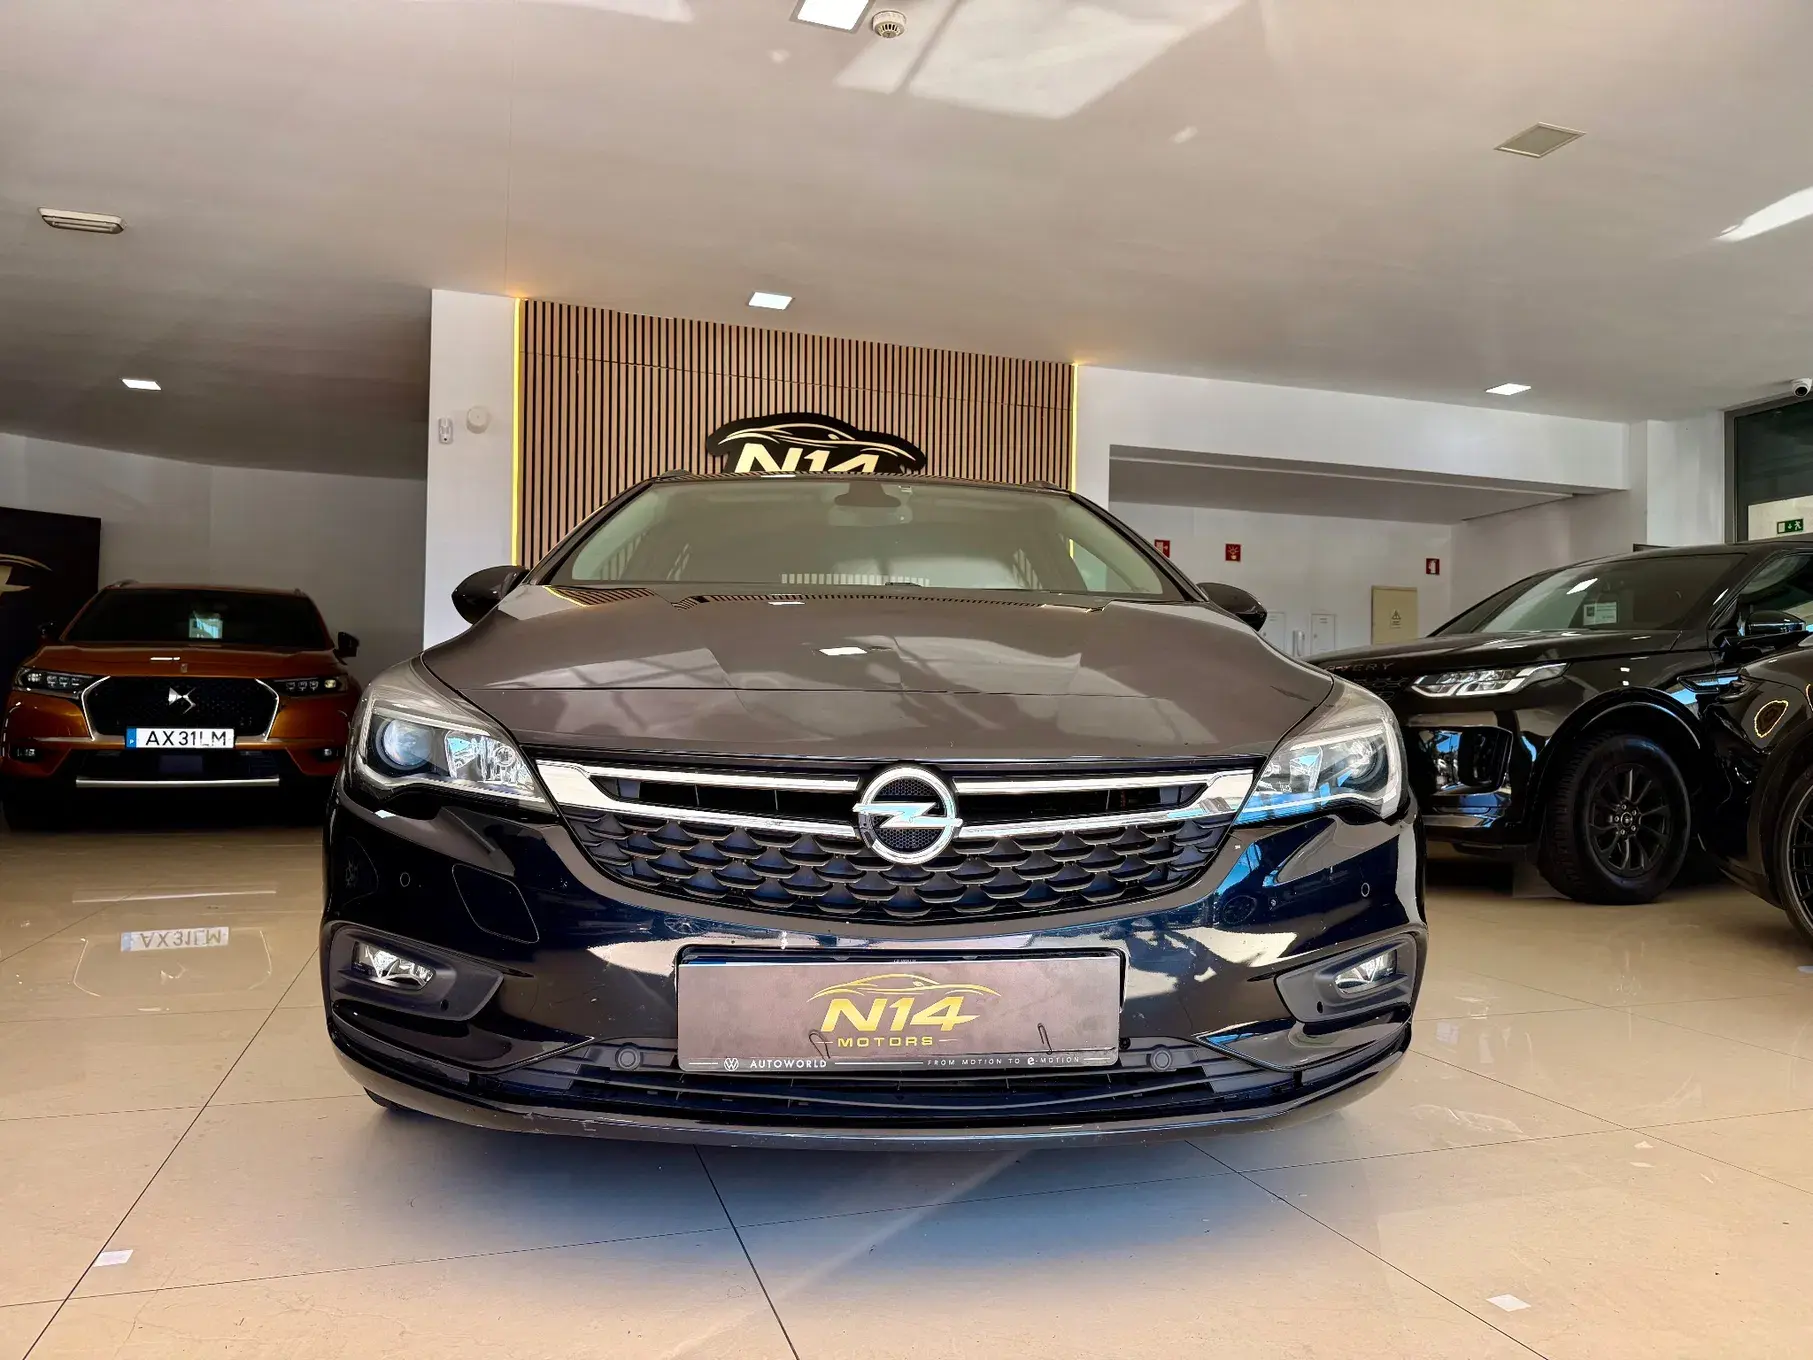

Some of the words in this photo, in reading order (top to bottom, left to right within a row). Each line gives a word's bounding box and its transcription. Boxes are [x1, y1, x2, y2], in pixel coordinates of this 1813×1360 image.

[734, 442, 880, 473] N14
[820, 996, 981, 1032] N14
[837, 1036, 933, 1048] MOTORS
[749, 1059, 827, 1069] AUTOWORLD
